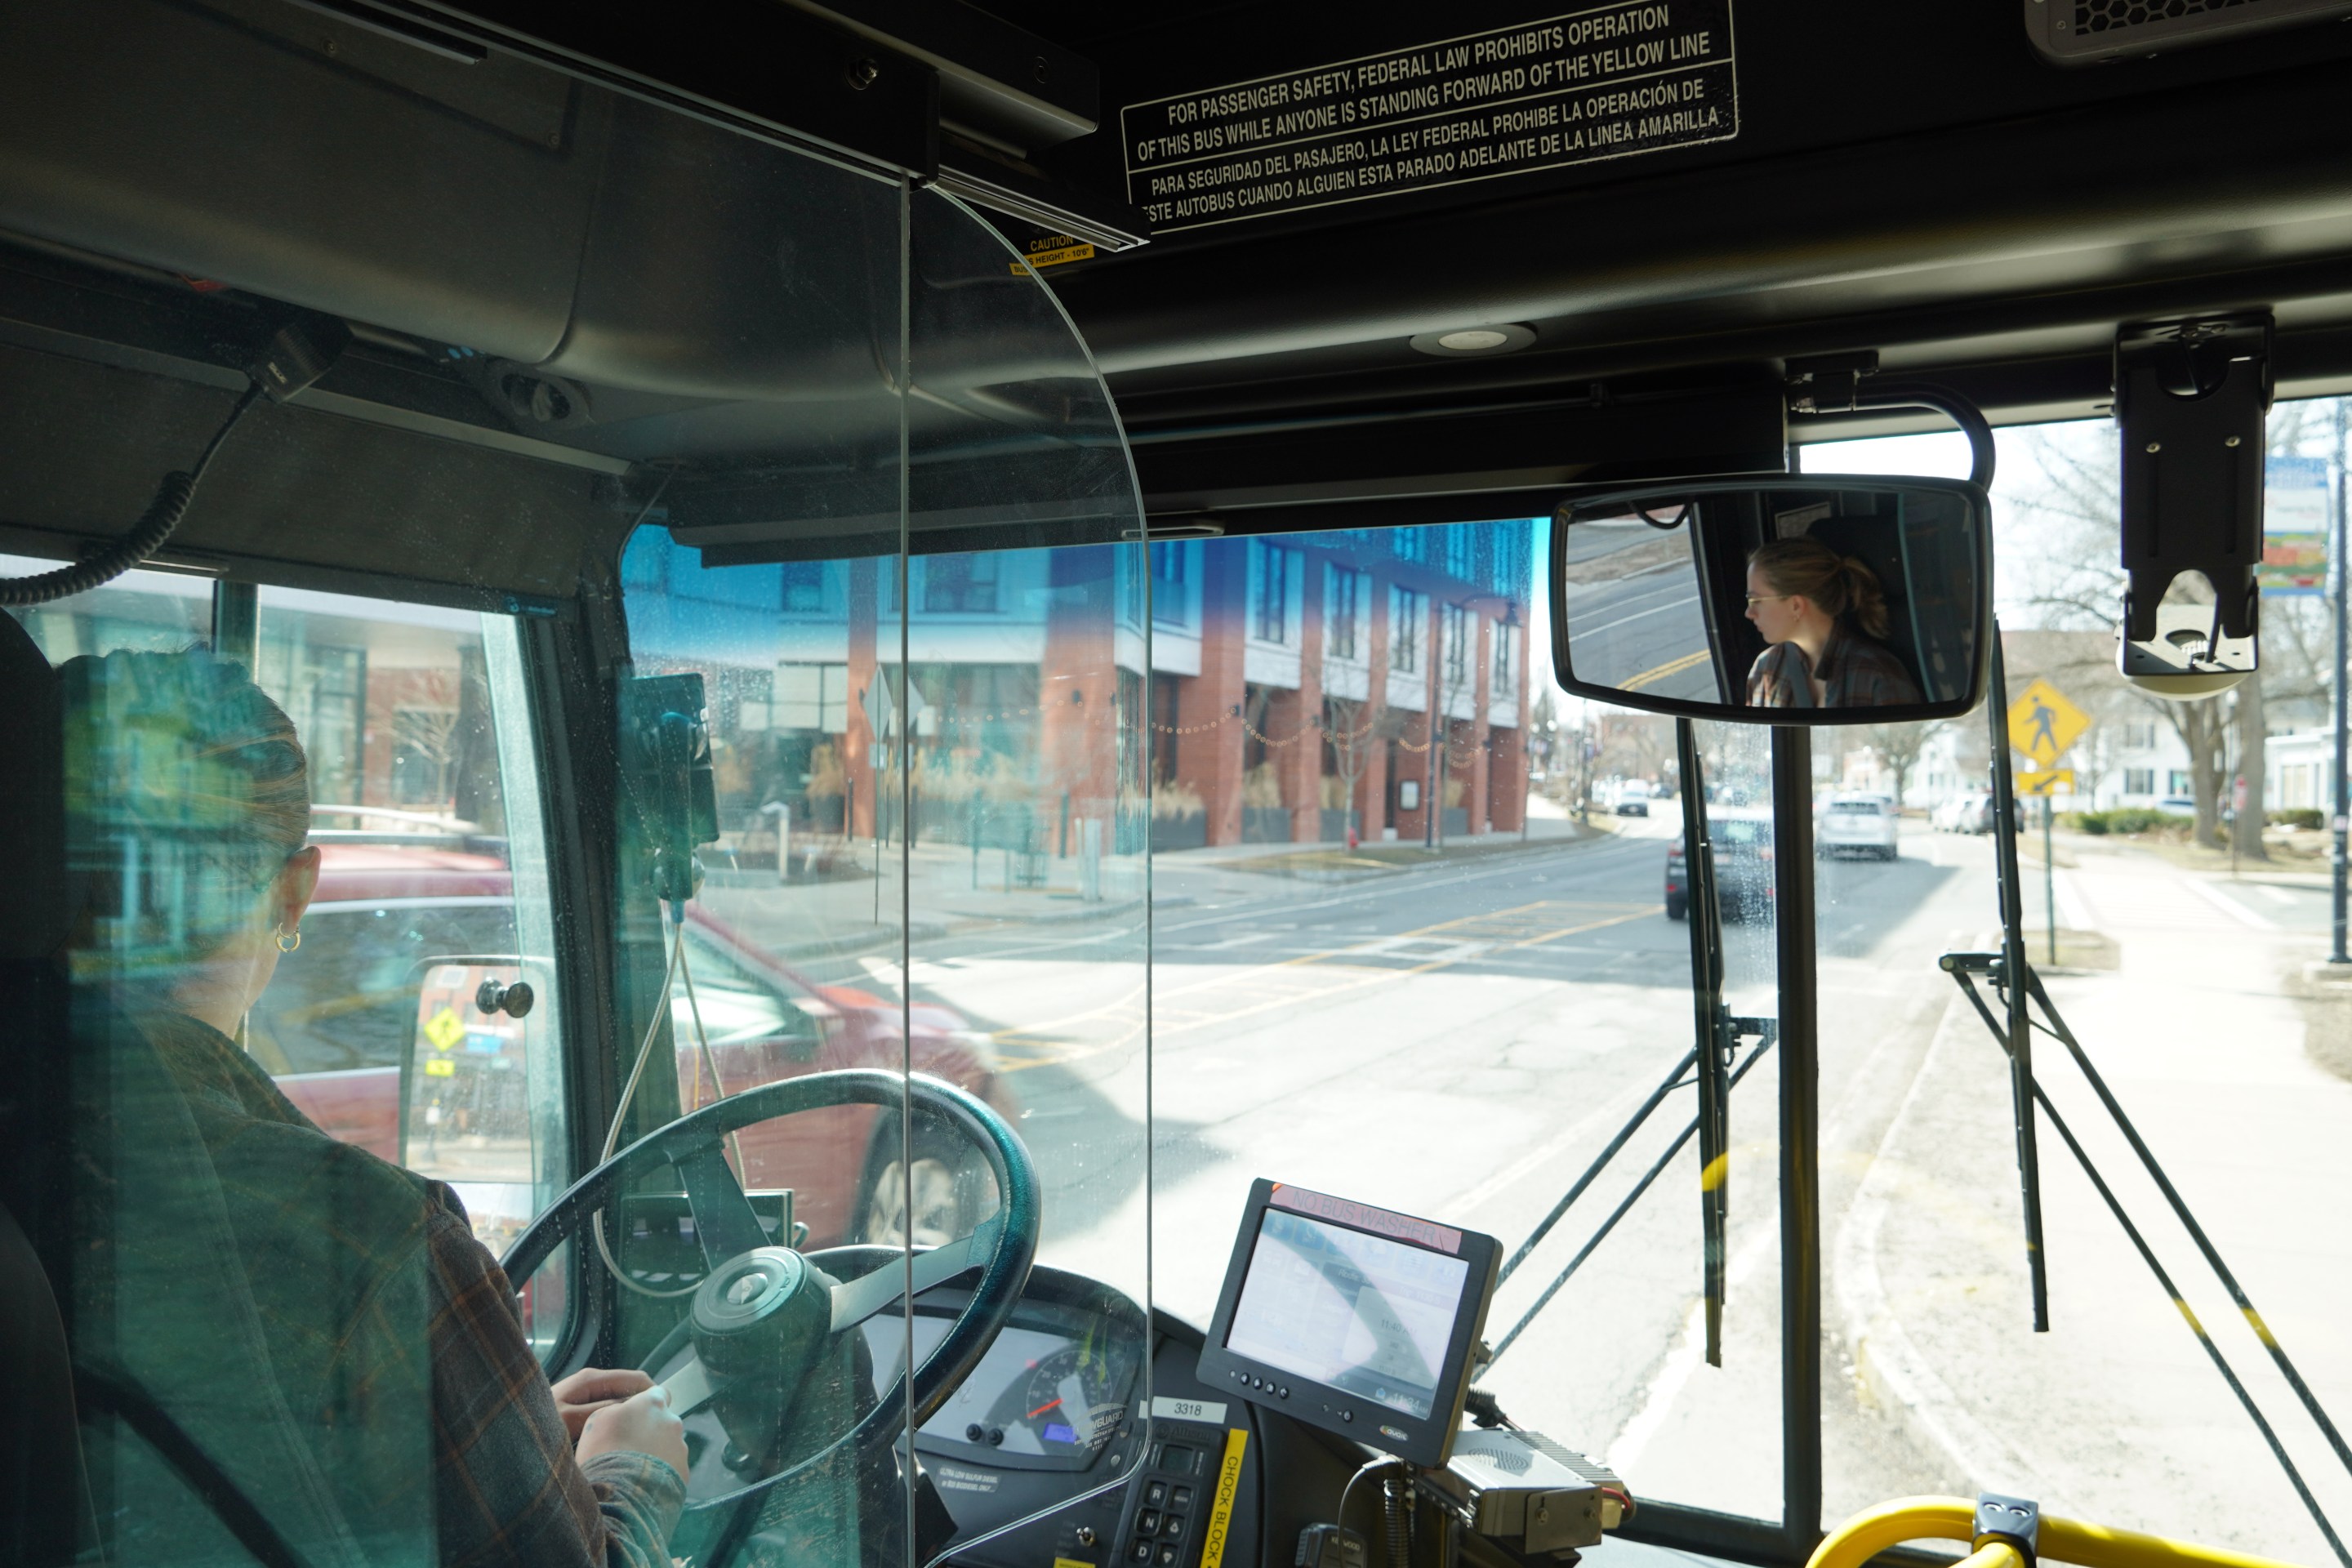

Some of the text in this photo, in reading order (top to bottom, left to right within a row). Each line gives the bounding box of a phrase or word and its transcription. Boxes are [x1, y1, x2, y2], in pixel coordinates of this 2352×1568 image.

[1169, 5, 1668, 125] FOR PASSENGER SAFETY, FEDERAL LAW PROHIBITS OPERATION
[1138, 31, 1710, 161] OF THIS BUS WHILE ANYONE IS STANDING FORWARD OF THE YELLOW LINE
[1152, 78, 1704, 195] PARA SEGURIDAD DEL PASAJERO, LA LEY FEDERAL PROHIBE LA OPERACIÓN DE
[1176, 191, 1235, 217] AUTOBUS
[1238, 180, 1293, 207] CUANDO
[1297, 170, 1355, 197] ALGUIEN
[1359, 163, 1393, 185] ESTA
[1397, 153, 1454, 179] PARADO
[1459, 138, 1536, 169] ADELANTE
[1540, 134, 1561, 154] DE
[1565, 130, 1584, 150] LA
[1588, 121, 1633, 147] LINEA
[1638, 106, 1719, 139] AMARILLA
[1030, 235, 1074, 252] CAUTION
[1036, 252, 1065, 264] HEIGHT
[1292, 1191, 1437, 1242] NO BUS WASHER
[1380, 1319, 1401, 1333] 11:40
[1174, 1402, 1201, 1416] 3318
[1152, 1489, 1161, 1499] R
[1207, 1456, 1239, 1561] CHOCK BLOCK
[1145, 1517, 1155, 1528] N
[1138, 1546, 1147, 1557] D
